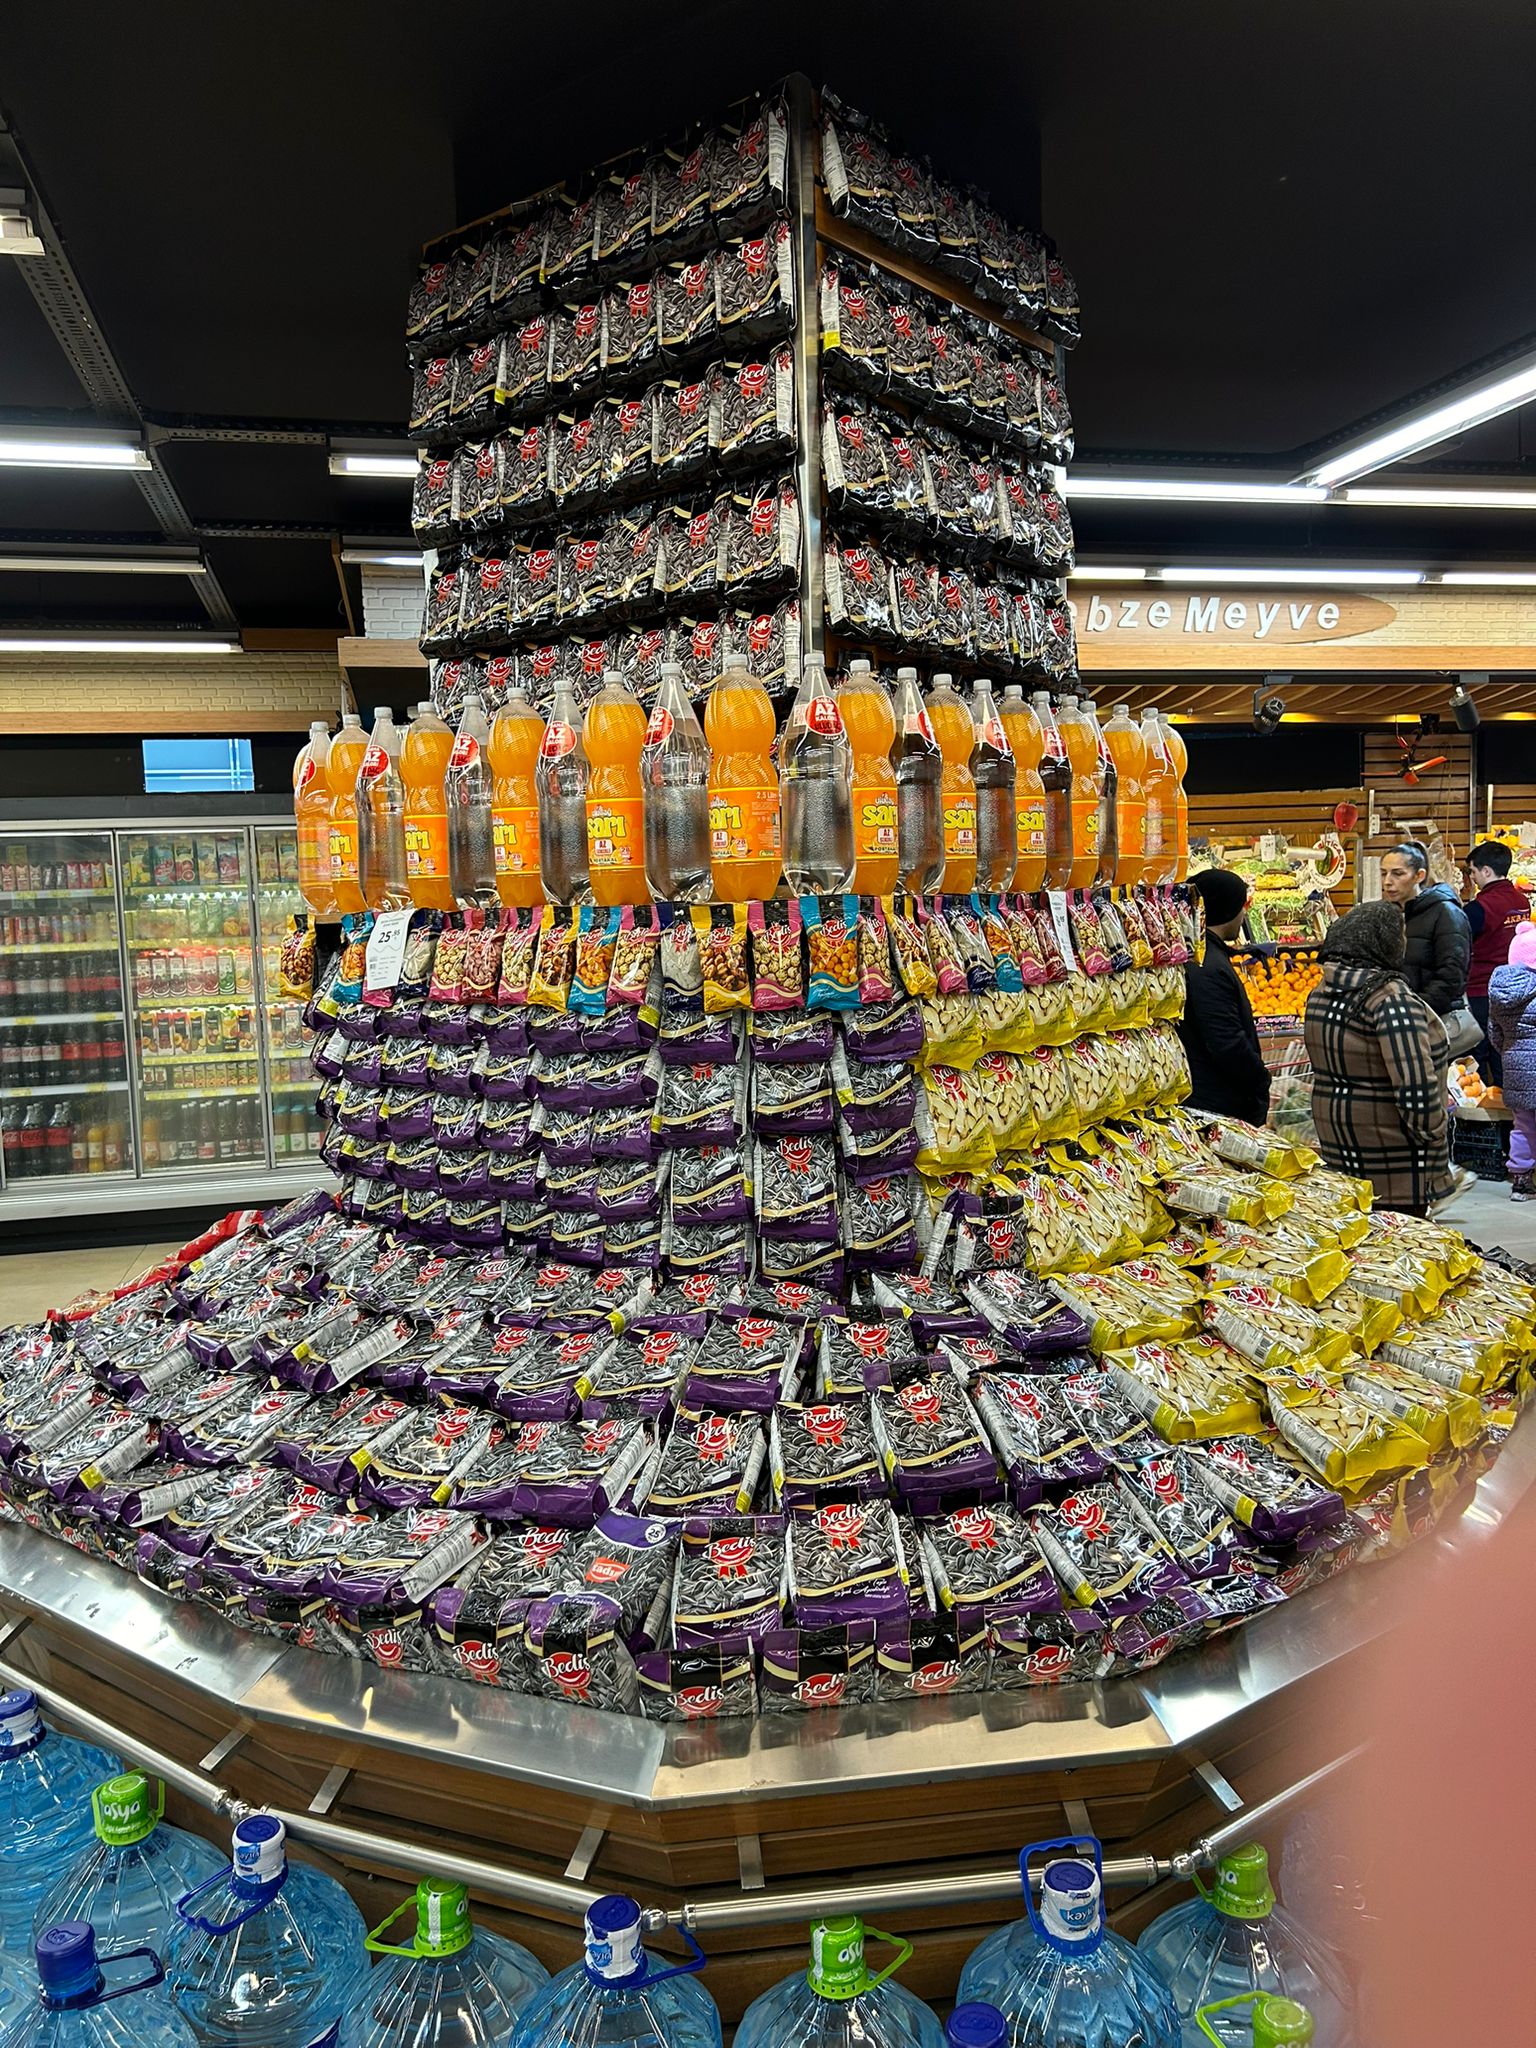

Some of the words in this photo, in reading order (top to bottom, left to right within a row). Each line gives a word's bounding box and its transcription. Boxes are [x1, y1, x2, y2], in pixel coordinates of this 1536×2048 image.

[1068, 595, 1173, 633] bze
[1183, 596, 1340, 640] Meyve
[815, 703, 836, 715] AZ
[455, 740, 470, 750] AZ
[547, 728, 566, 739] AZ
[365, 751, 381, 761] AZ
[384, 931, 401, 943] 25
[777, 1136, 814, 1154] Bedis
[984, 1218, 1016, 1245] Bedis
[680, 1275, 721, 1291] Bedis
[770, 1282, 815, 1296] Bedis
[898, 1383, 940, 1405] Bedis
[801, 1403, 848, 1427] Bedis
[692, 1420, 741, 1443] Bedis
[287, 1485, 328, 1505] Bedis
[811, 1503, 865, 1530] Bedis
[1058, 1491, 1097, 1524] Bedis
[945, 1506, 991, 1535] Bedis
[518, 1526, 571, 1548] Bedis
[649, 1528, 661, 1538] 25
[702, 1536, 756, 1559] Bedis
[364, 1628, 406, 1651] Bedis
[453, 1641, 499, 1665] Bedis
[541, 1653, 592, 1680] Bedis
[904, 1659, 962, 1690] Bedis
[667, 1686, 726, 1707] Bedis
[103, 1799, 142, 1825] asya
[837, 1941, 863, 1965] asy
